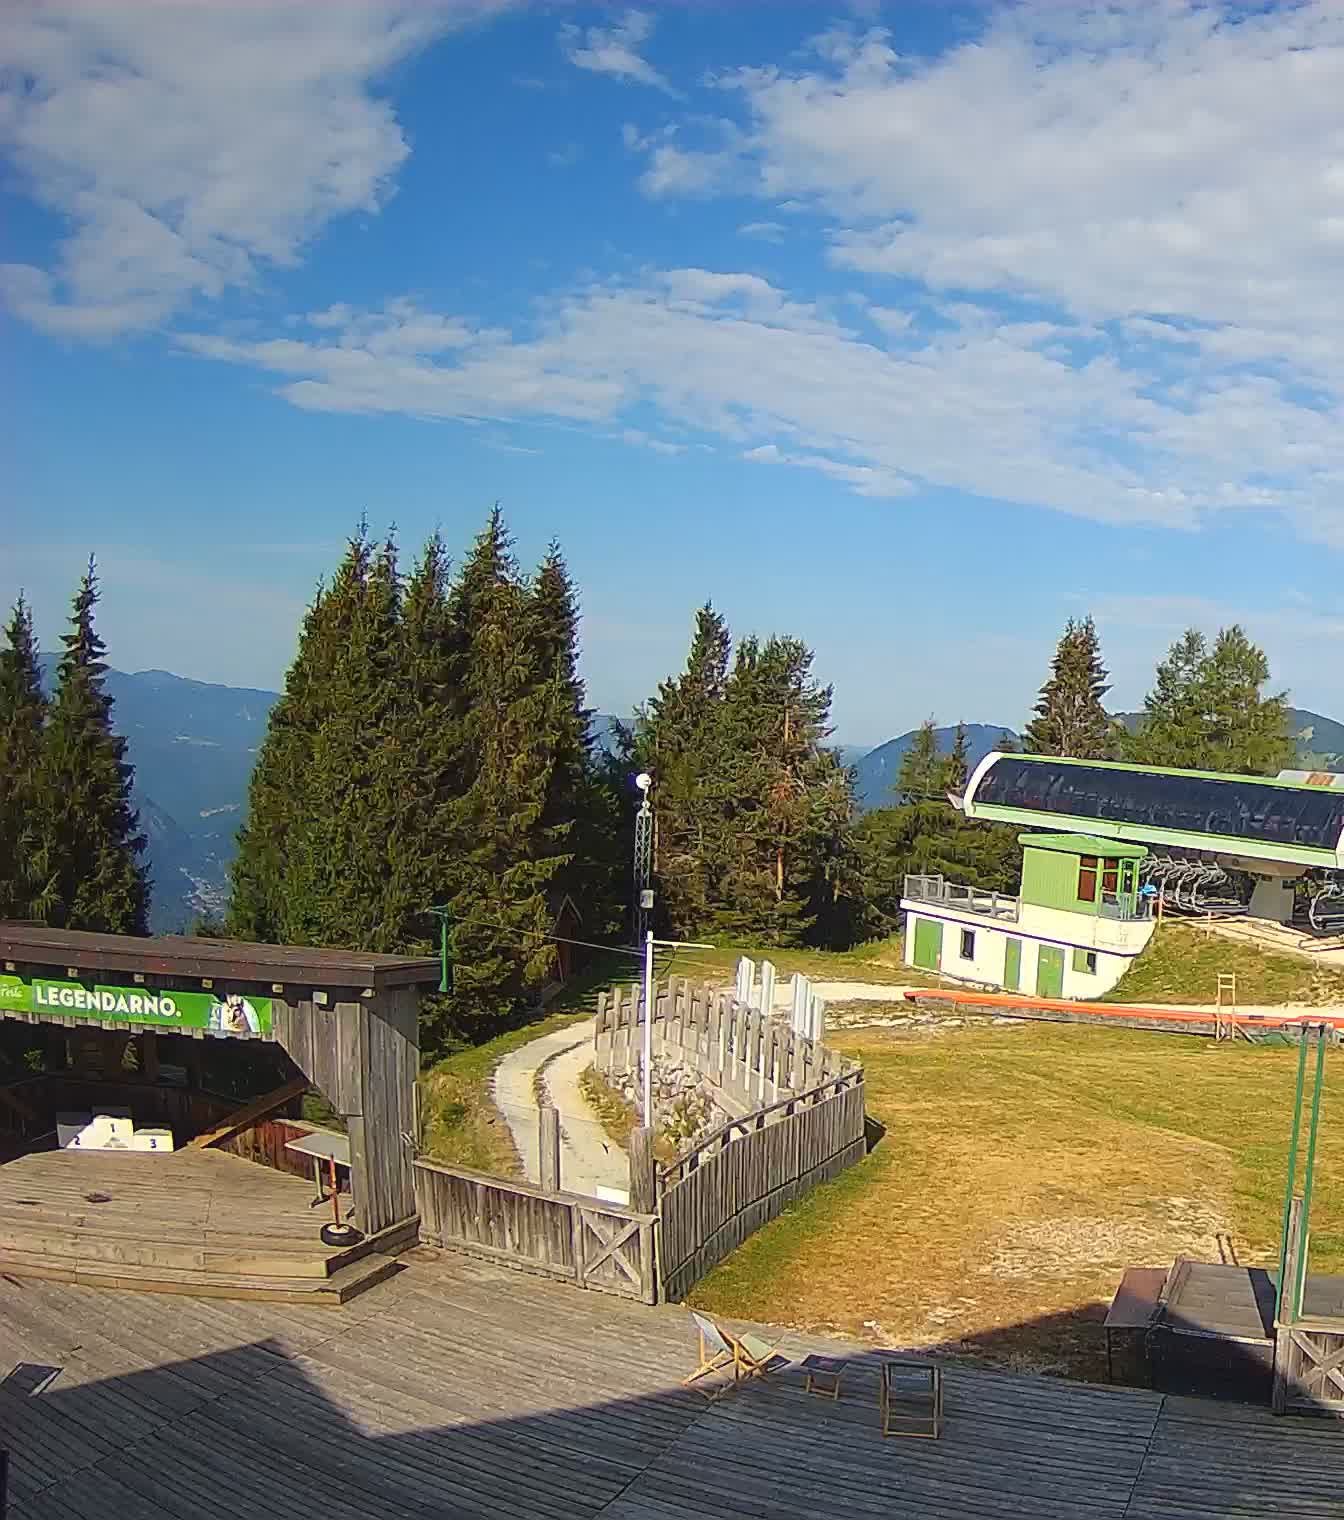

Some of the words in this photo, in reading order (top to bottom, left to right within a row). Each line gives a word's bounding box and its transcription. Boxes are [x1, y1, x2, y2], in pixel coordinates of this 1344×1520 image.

[36, 985, 182, 1017] LEGENDARNO.
[109, 1123, 115, 1133] 1
[74, 1135, 81, 1146] 2
[149, 1138, 157, 1149] 3
